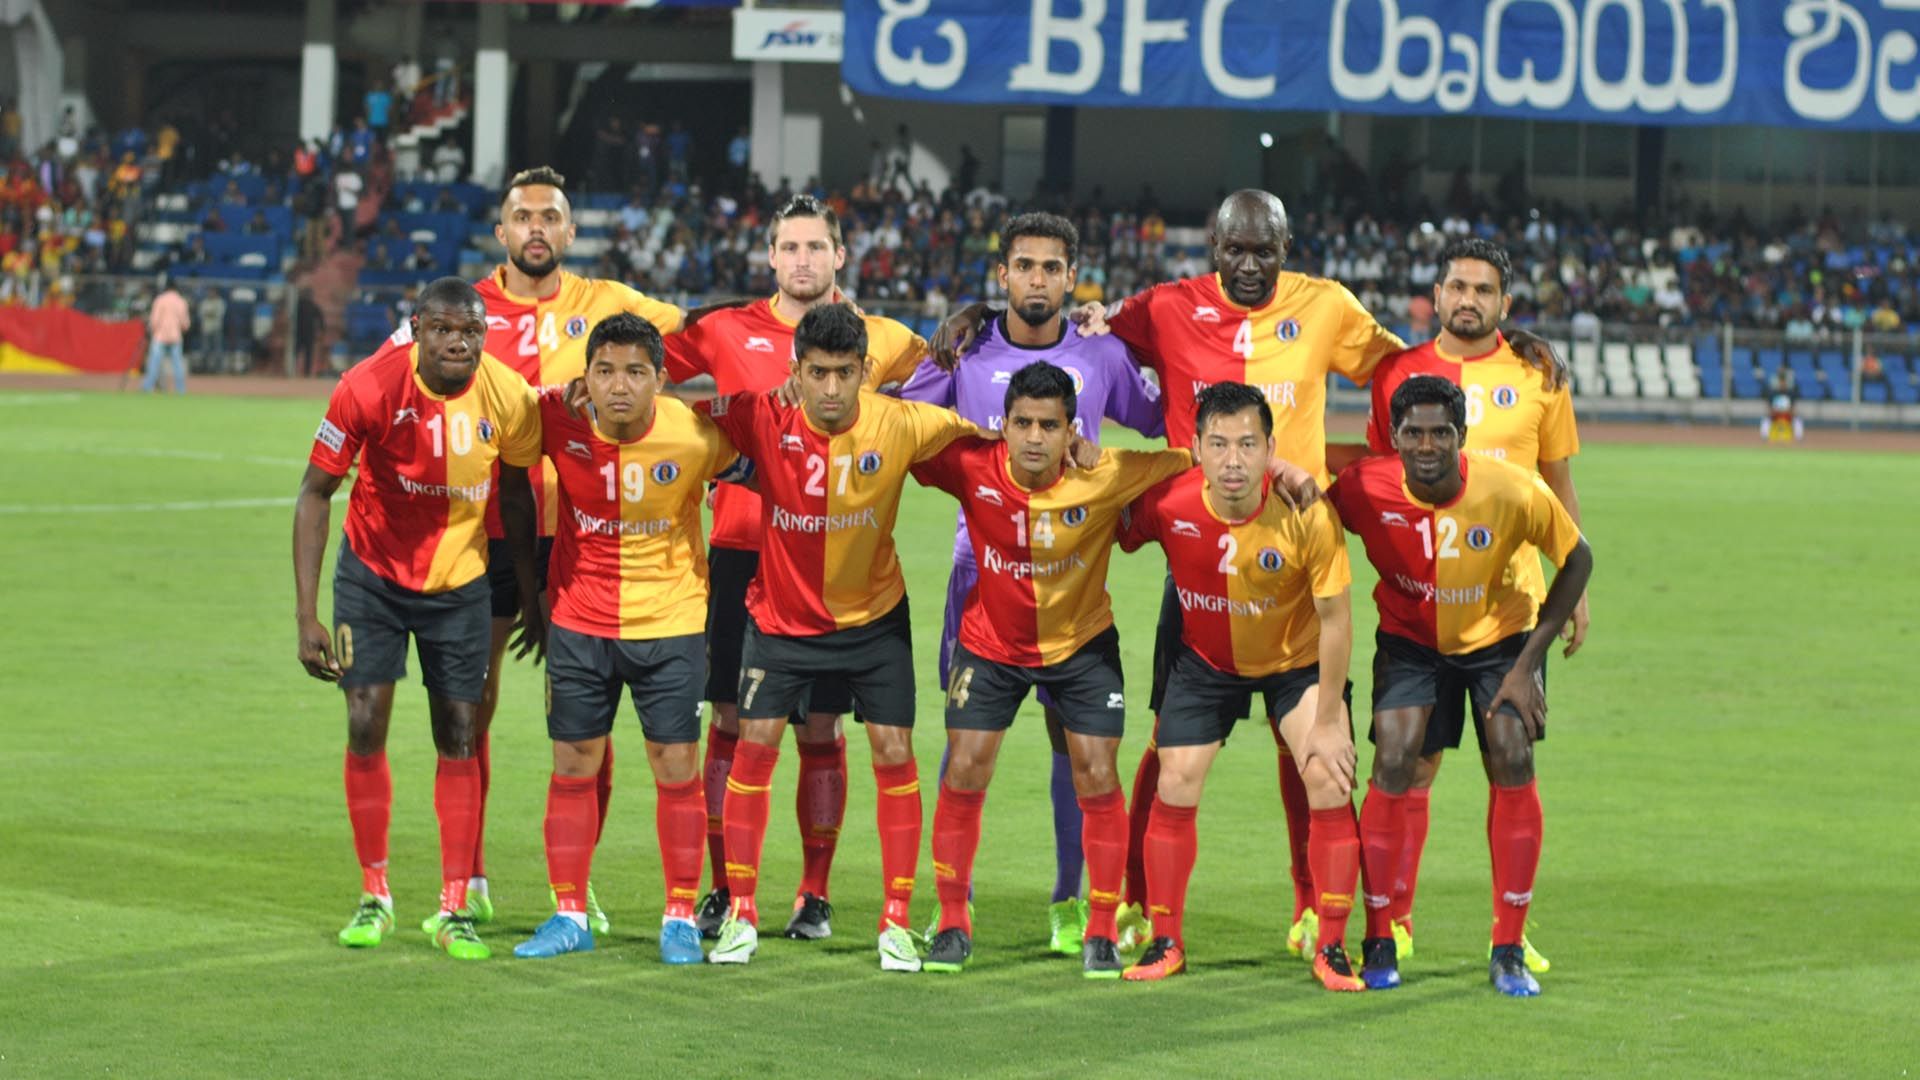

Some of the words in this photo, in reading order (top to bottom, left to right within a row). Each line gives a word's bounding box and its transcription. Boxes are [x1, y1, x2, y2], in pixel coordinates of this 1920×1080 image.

[517, 311, 560, 356] 24
[1232, 319, 1255, 360] 4
[427, 411, 473, 458] 10
[600, 461, 645, 503] 19
[804, 453, 853, 497] 27
[771, 504, 878, 533] KINGFISHER
[1010, 510, 1056, 549] 14
[1415, 516, 1460, 560] 12
[1217, 533, 1238, 576] 2
